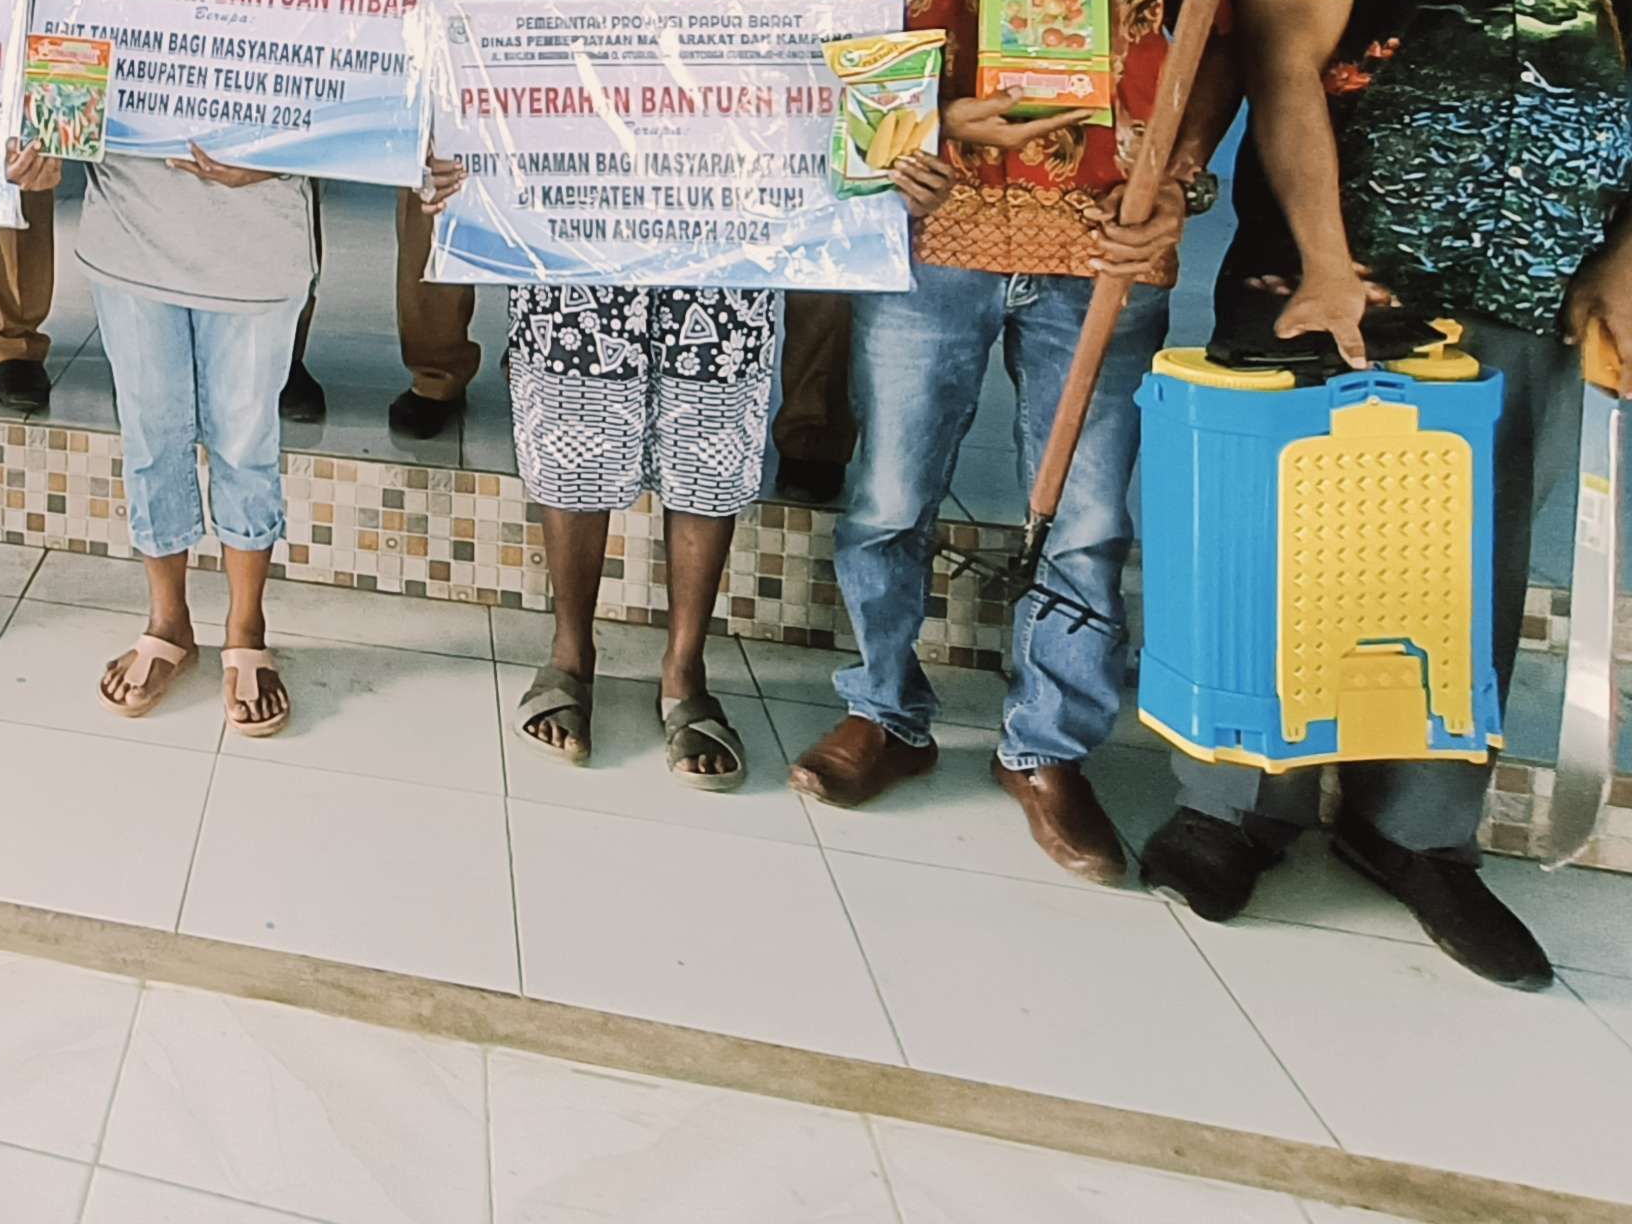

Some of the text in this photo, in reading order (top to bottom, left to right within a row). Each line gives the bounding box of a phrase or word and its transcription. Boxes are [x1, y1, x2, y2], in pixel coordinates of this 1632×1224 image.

[688, 15, 743, 29] PAPUA
[748, 15, 804, 29] BARAT
[90, 25, 164, 51] TANAMAN
[169, 32, 206, 55] BAGI
[211, 36, 326, 69] MASYARAKAT
[481, 35, 522, 48] DINAS
[637, 33, 737, 46] MAARAKAT
[115, 58, 346, 102] KABUPATEN TELUK BINTUNI
[118, 89, 312, 131] TAHUN ANGGARAN 2024
[641, 84, 774, 117] BANTUAN
[595, 151, 640, 175] BAGI
[651, 186, 714, 208] TELUK
[548, 218, 771, 243] TAHUN ANGGARAN 2024
